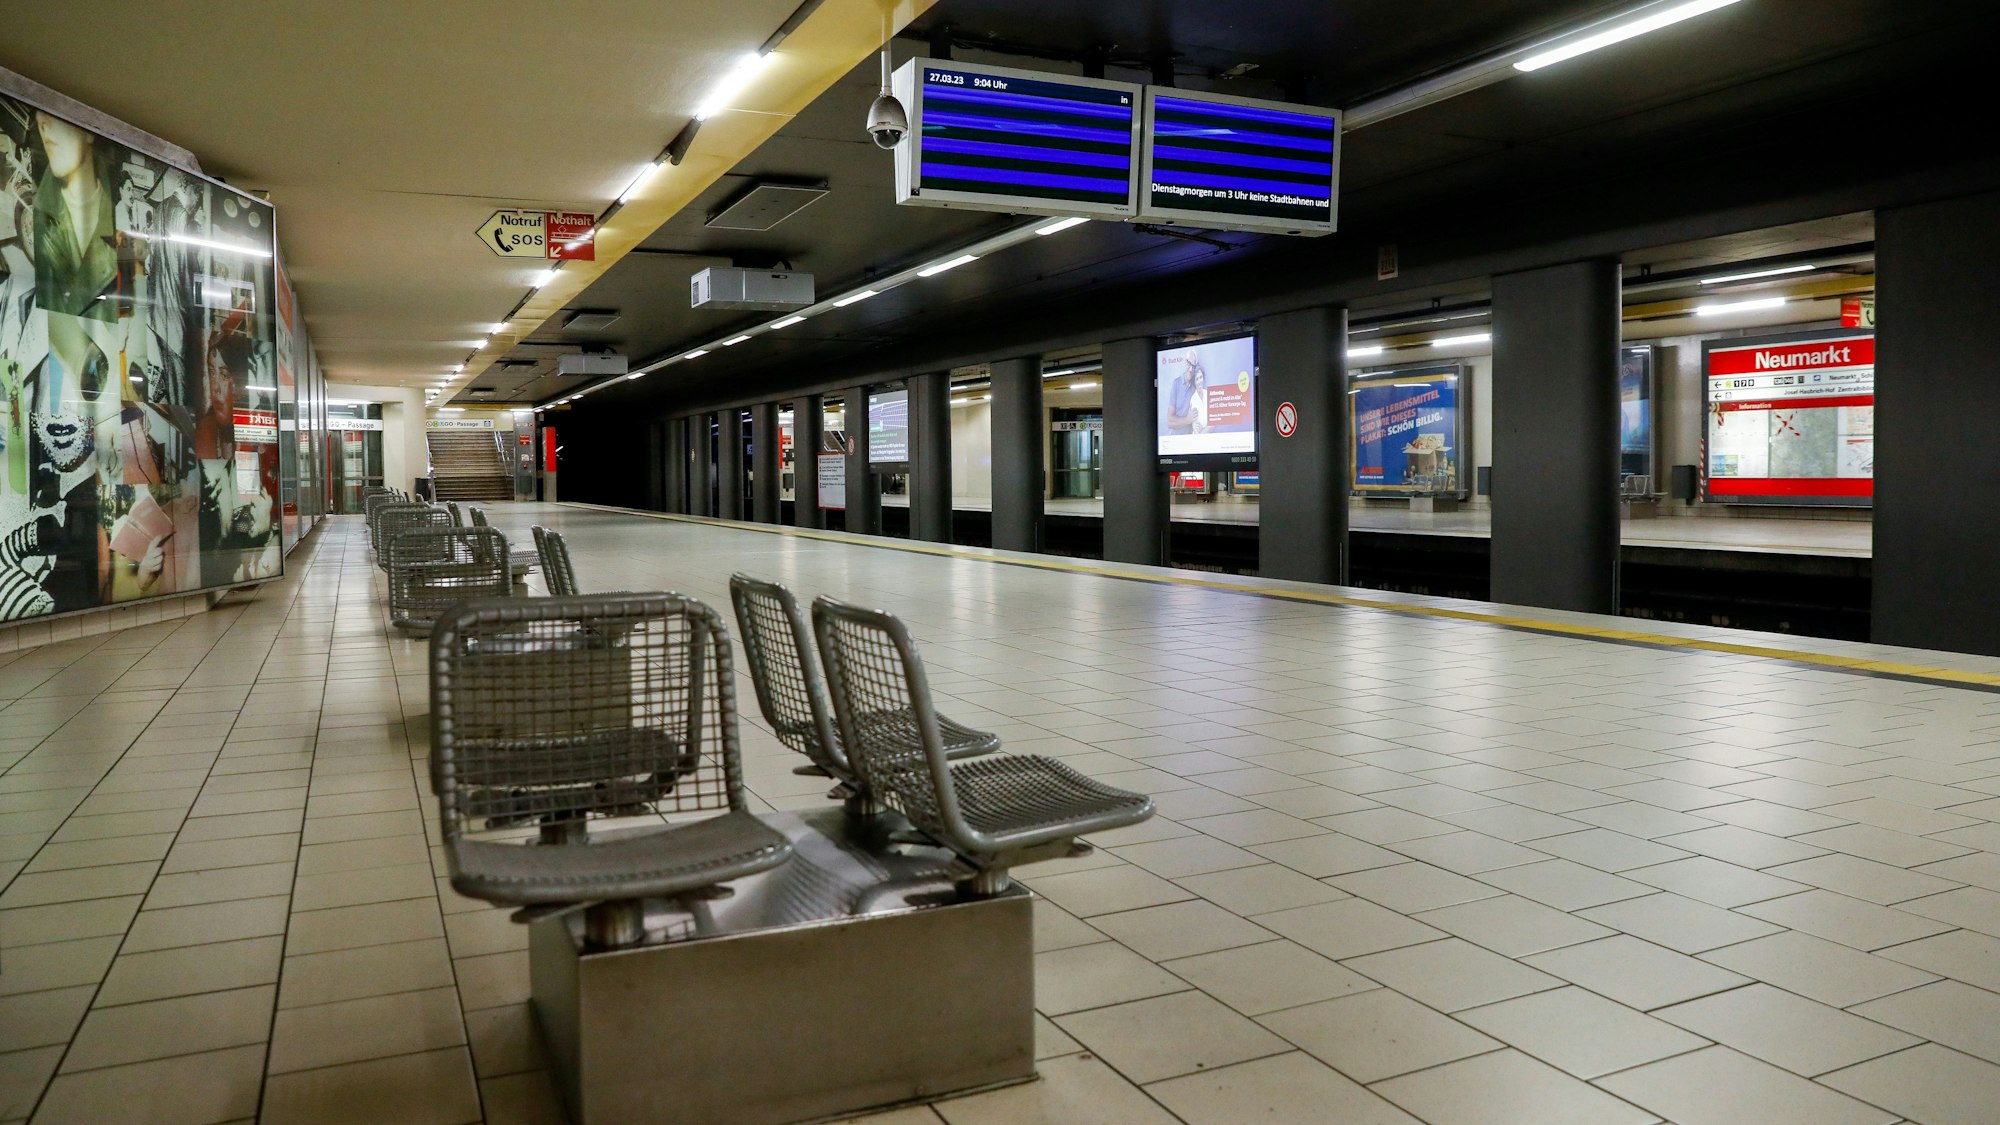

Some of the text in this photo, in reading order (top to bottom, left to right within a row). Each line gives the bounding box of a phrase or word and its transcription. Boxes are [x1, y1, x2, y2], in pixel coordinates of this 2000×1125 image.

[930, 73, 1008, 90] 27.03.23 9:04 Uhr
[1120, 95, 1128, 105] in
[1152, 183, 1329, 208] Dienstagmorgen um 3 Uhr keine Stadtbahnen und
[501, 214, 592, 227] Notruf Nothalt
[511, 234, 543, 246] SOS
[1755, 345, 1851, 370] Neumarkt
[1829, 373, 1857, 381] Neumarkt
[1361, 389, 1440, 423] UNSERE LEBENSMITTEL
[347, 421, 375, 430] Passage
[1360, 409, 1417, 433] SIND WIE DIESES
[1361, 411, 1443, 445] PLAKAT: SCHÖN BILLIG.
